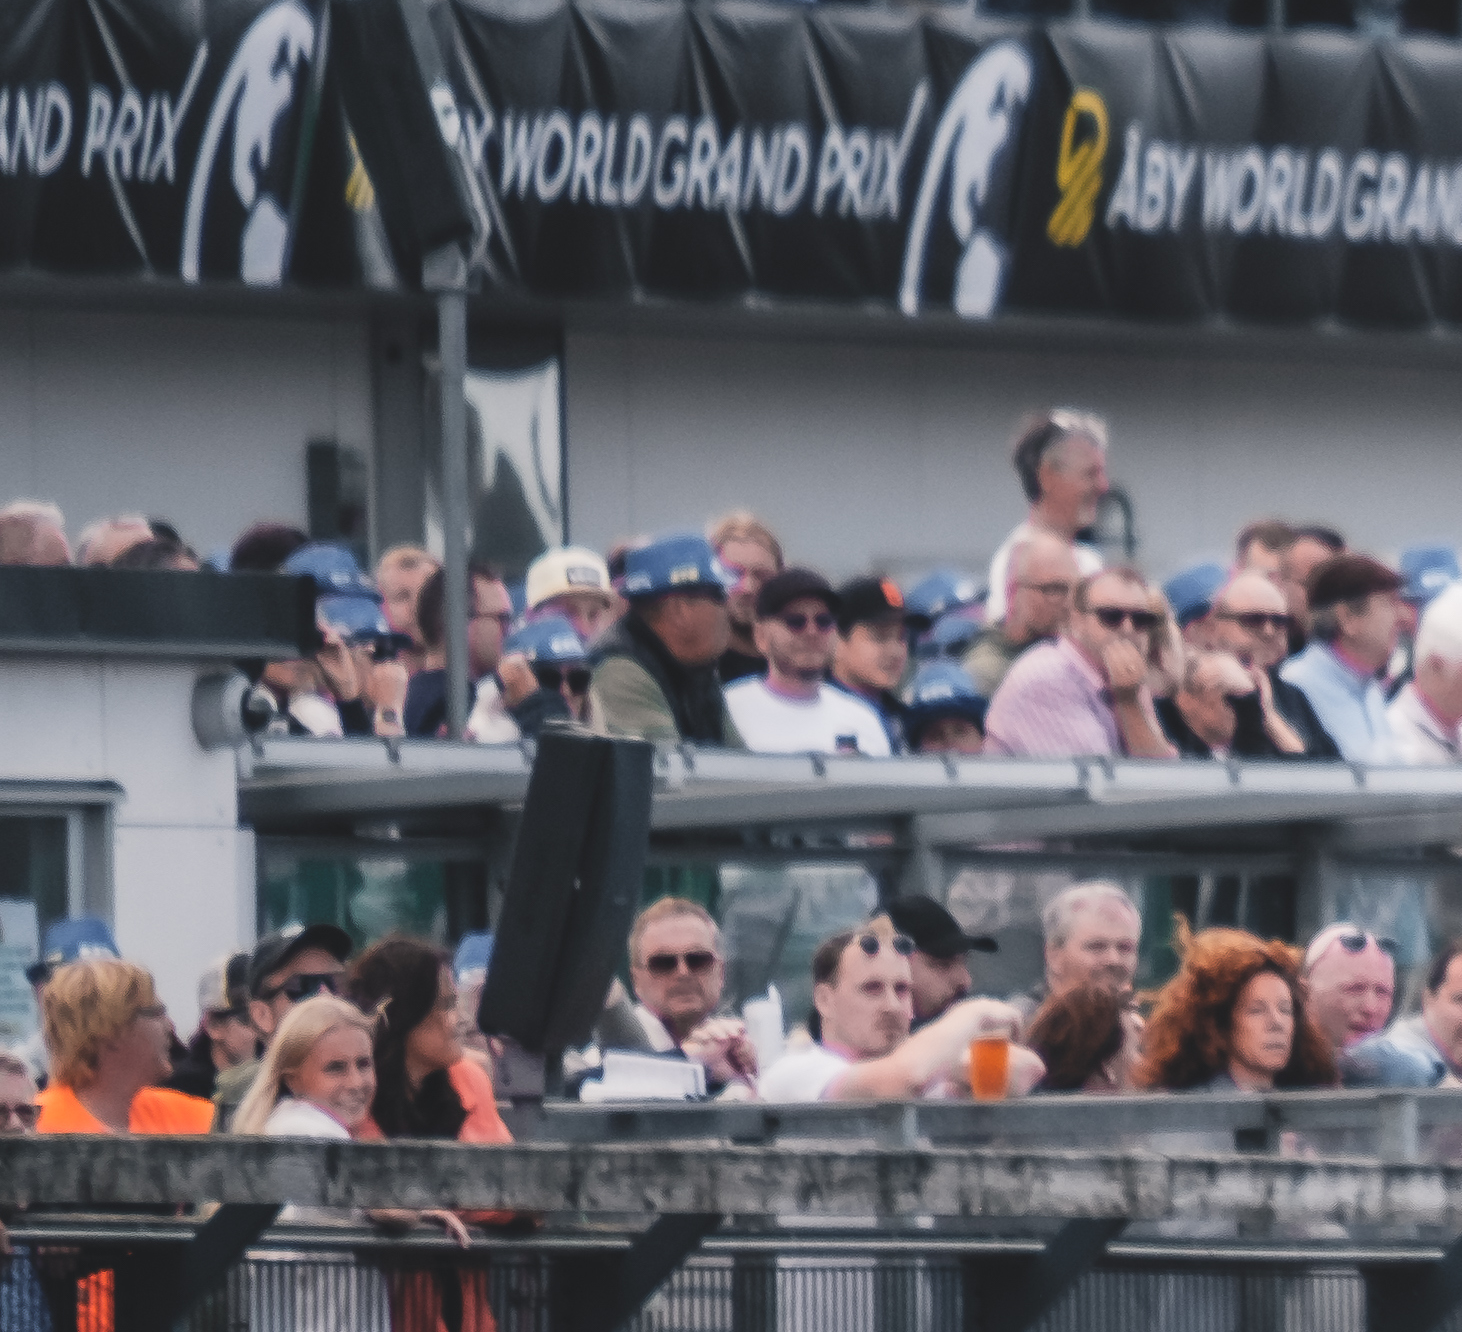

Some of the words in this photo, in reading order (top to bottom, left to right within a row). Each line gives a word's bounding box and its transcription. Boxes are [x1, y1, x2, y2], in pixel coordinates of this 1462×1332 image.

[500, 106, 653, 208] WORLD
[653, 112, 809, 218] GRAND
[811, 75, 929, 221] PRIX
[1201, 142, 1344, 243] WORLD
